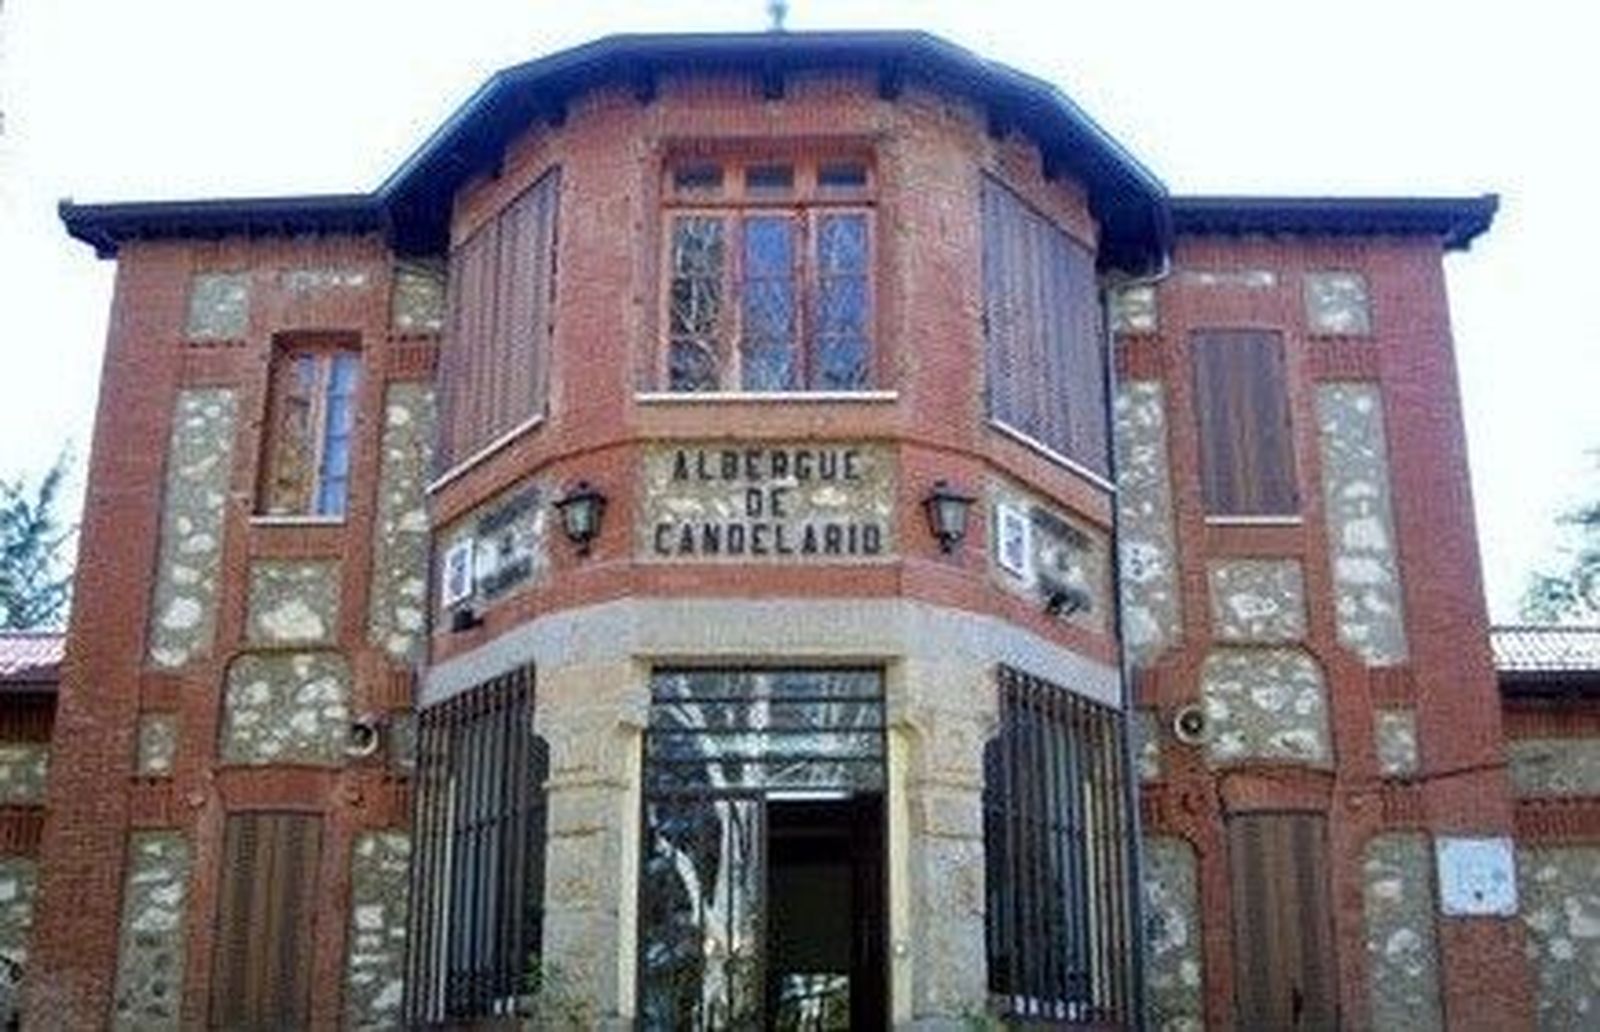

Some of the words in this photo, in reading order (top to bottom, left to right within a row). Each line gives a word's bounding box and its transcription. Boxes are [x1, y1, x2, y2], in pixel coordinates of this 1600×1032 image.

[673, 450, 861, 480] ALBERGUE
[746, 487, 786, 517] DE
[654, 523, 882, 554] CANDELARIO
